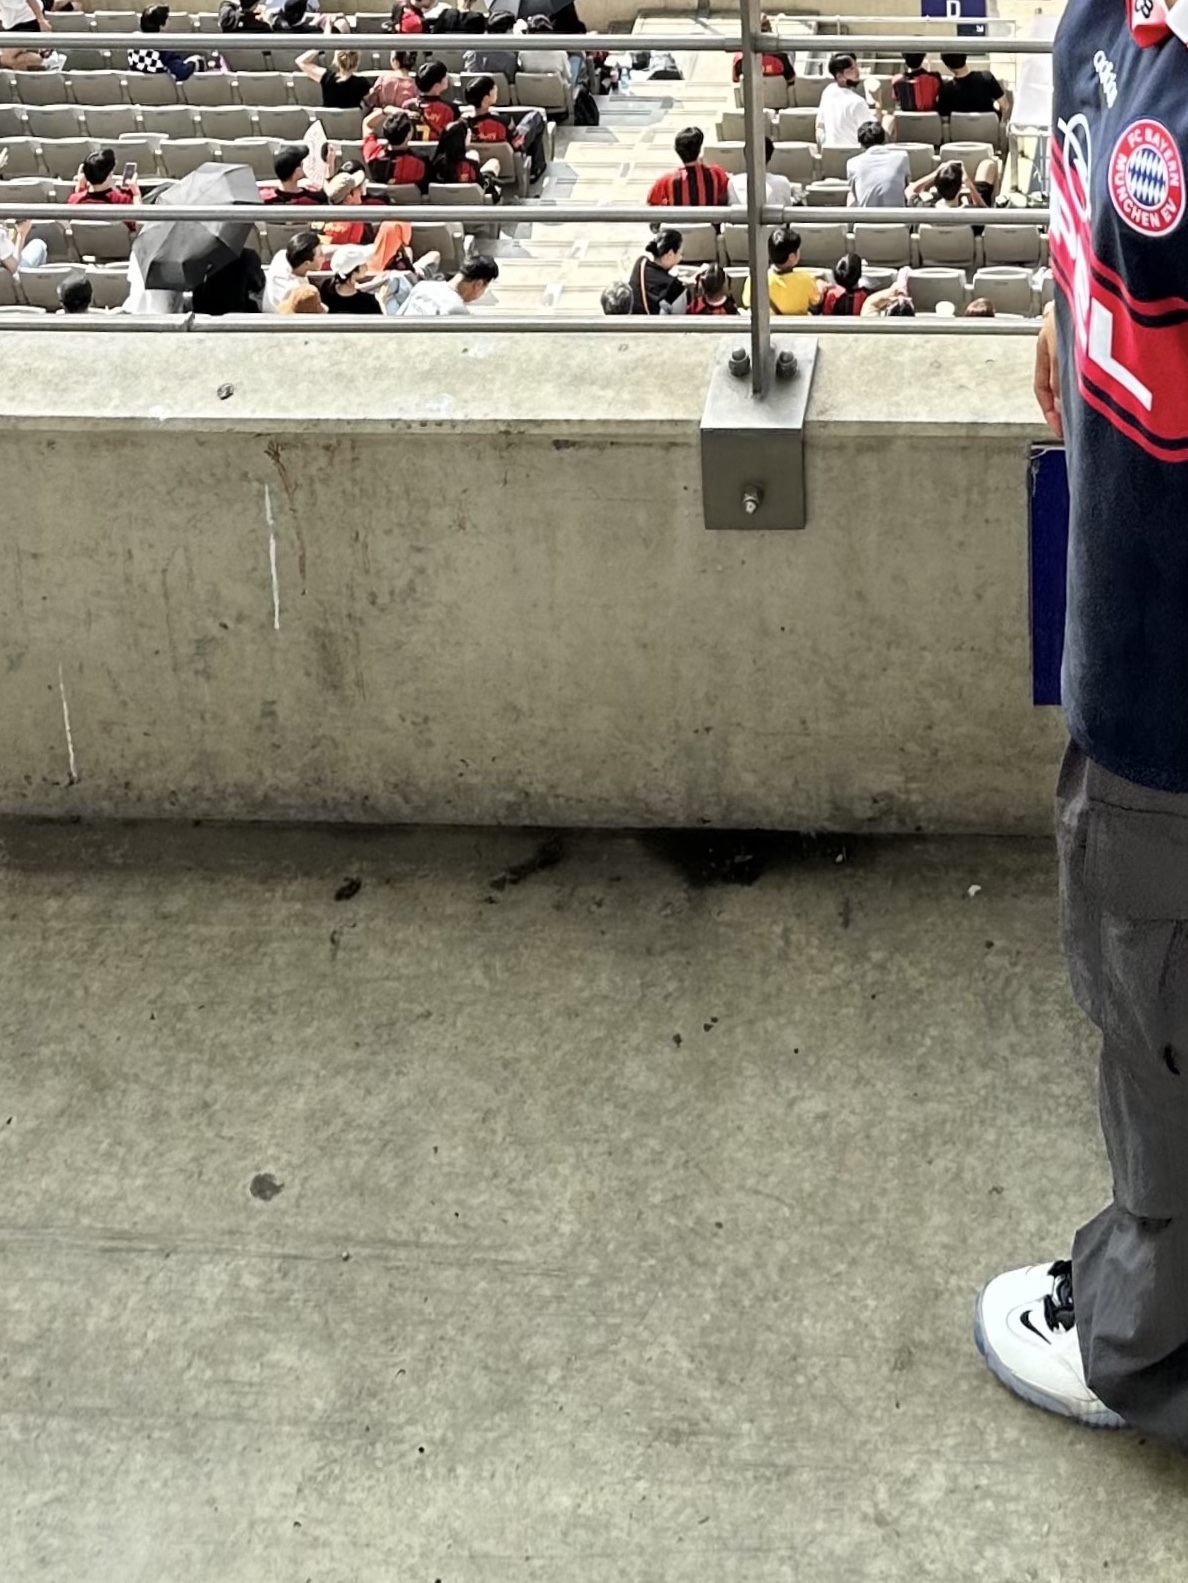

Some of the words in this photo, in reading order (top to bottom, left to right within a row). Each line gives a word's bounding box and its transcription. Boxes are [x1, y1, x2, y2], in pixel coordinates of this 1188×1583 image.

[945, 0, 961, 18] D
[1127, 128, 1143, 149] FC
[1145, 127, 1180, 187] BAYERN
